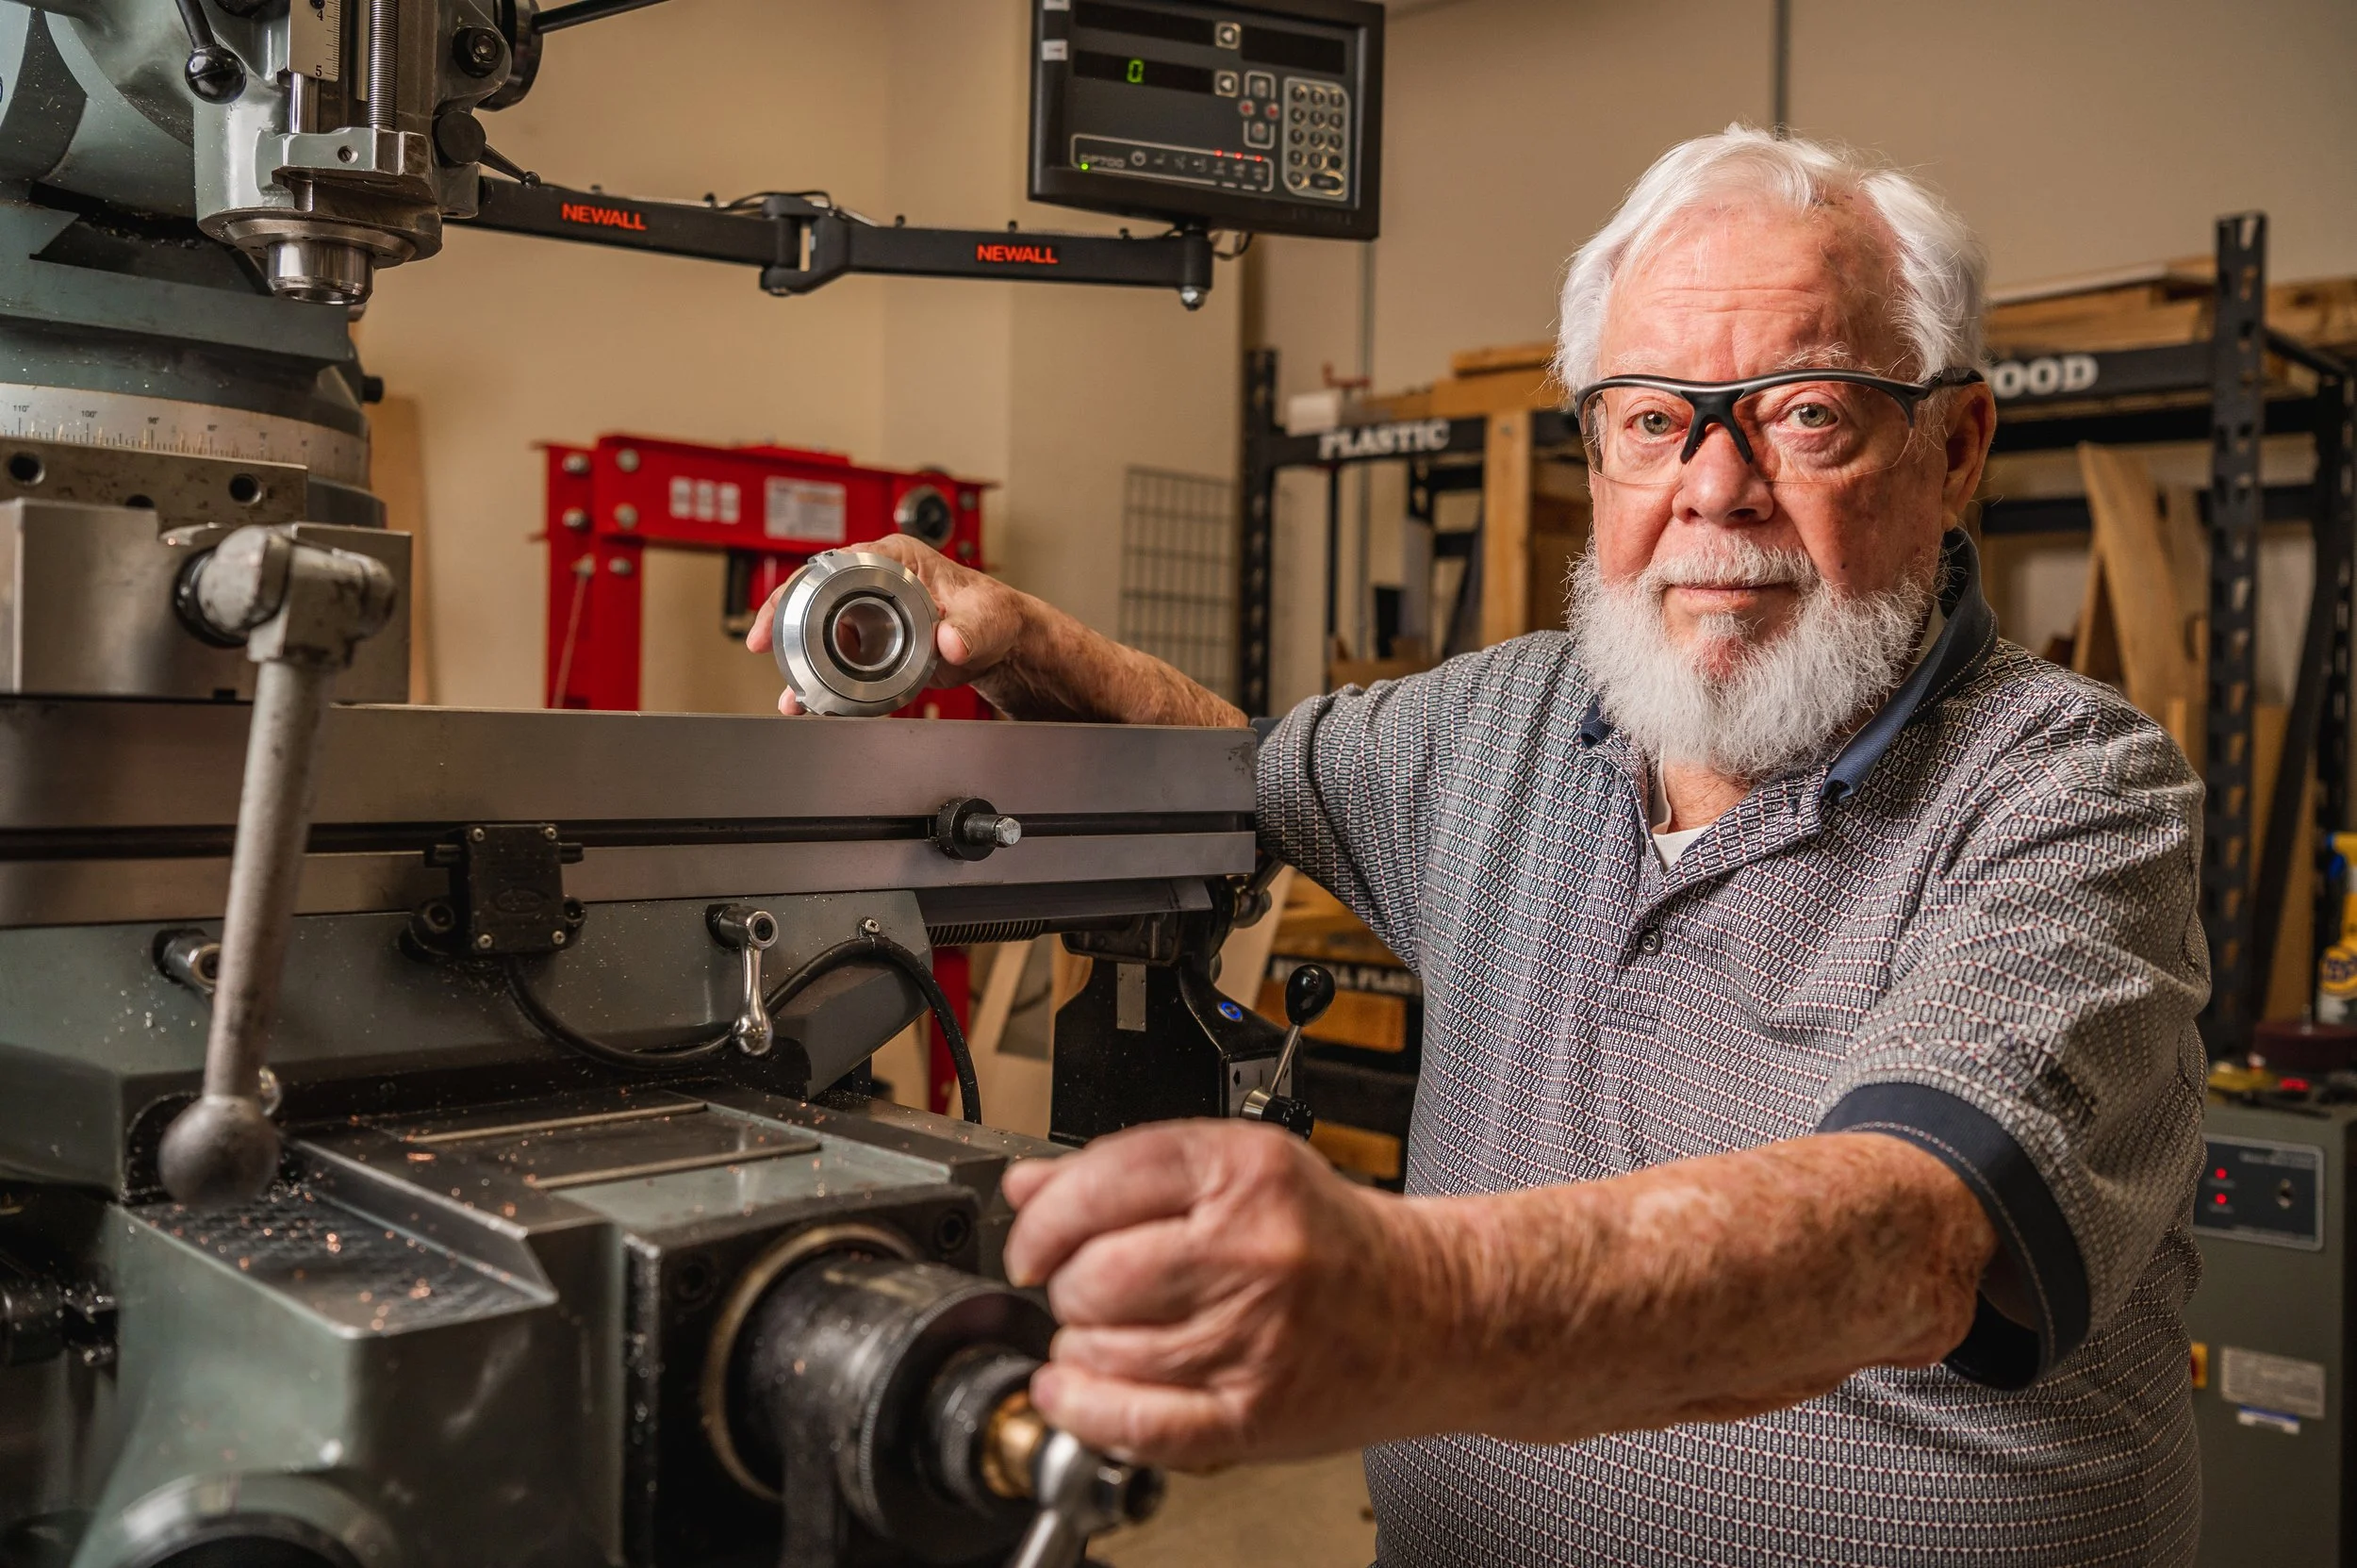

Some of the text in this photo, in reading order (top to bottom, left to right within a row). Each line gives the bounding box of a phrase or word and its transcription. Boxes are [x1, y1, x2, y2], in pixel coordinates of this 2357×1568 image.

[317, 9, 323, 21] 4
[315, 65, 322, 76] 5
[1127, 59, 1144, 83] 0
[562, 203, 648, 231] NEWALL
[977, 244, 1059, 264] NEWALL
[1987, 355, 2099, 399] OOD
[1318, 418, 1450, 460] PLASTIC
